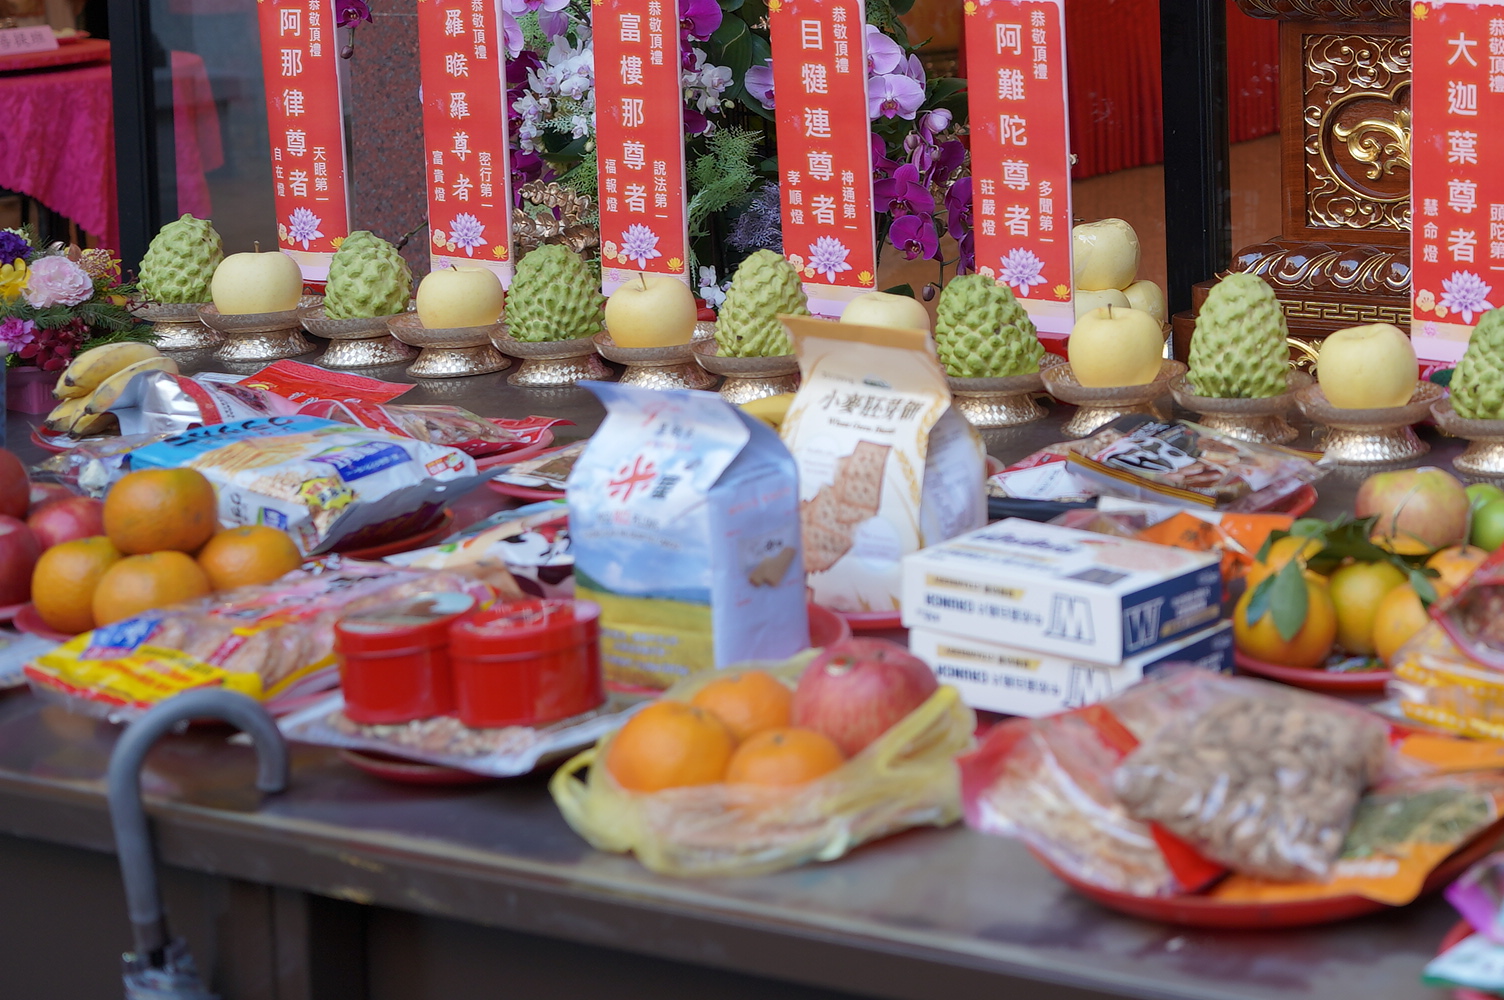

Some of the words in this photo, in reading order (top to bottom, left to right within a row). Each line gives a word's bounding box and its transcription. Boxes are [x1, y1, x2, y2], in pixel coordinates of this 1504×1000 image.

[648, 0, 664, 66] 恭敬頂禮
[832, 6, 850, 74] 恭敬頂禮
[1030, 10, 1049, 80] 恭敬頂禮
[280, 8, 310, 198] 阿那律尊者
[619, 13, 648, 214] 富樓那尊者
[802, 19, 836, 226] 目犍連尊者
[996, 23, 1032, 237] 阿難陀尊者
[274, 148, 286, 198] 自在燈
[314, 146, 329, 201] 天眼第一
[432, 150, 446, 202] 富貴燈
[478, 152, 494, 208] 密行第一
[1446, 32, 1478, 264] 大迦葉尊者
[604, 159, 618, 212] 福報燈
[787, 170, 804, 226] 孝順燈
[841, 170, 858, 230] 神通第一
[980, 179, 996, 236] 莊嚴燈
[1038, 180, 1054, 243] 多聞第一
[1423, 198, 1439, 264] 慧命燈
